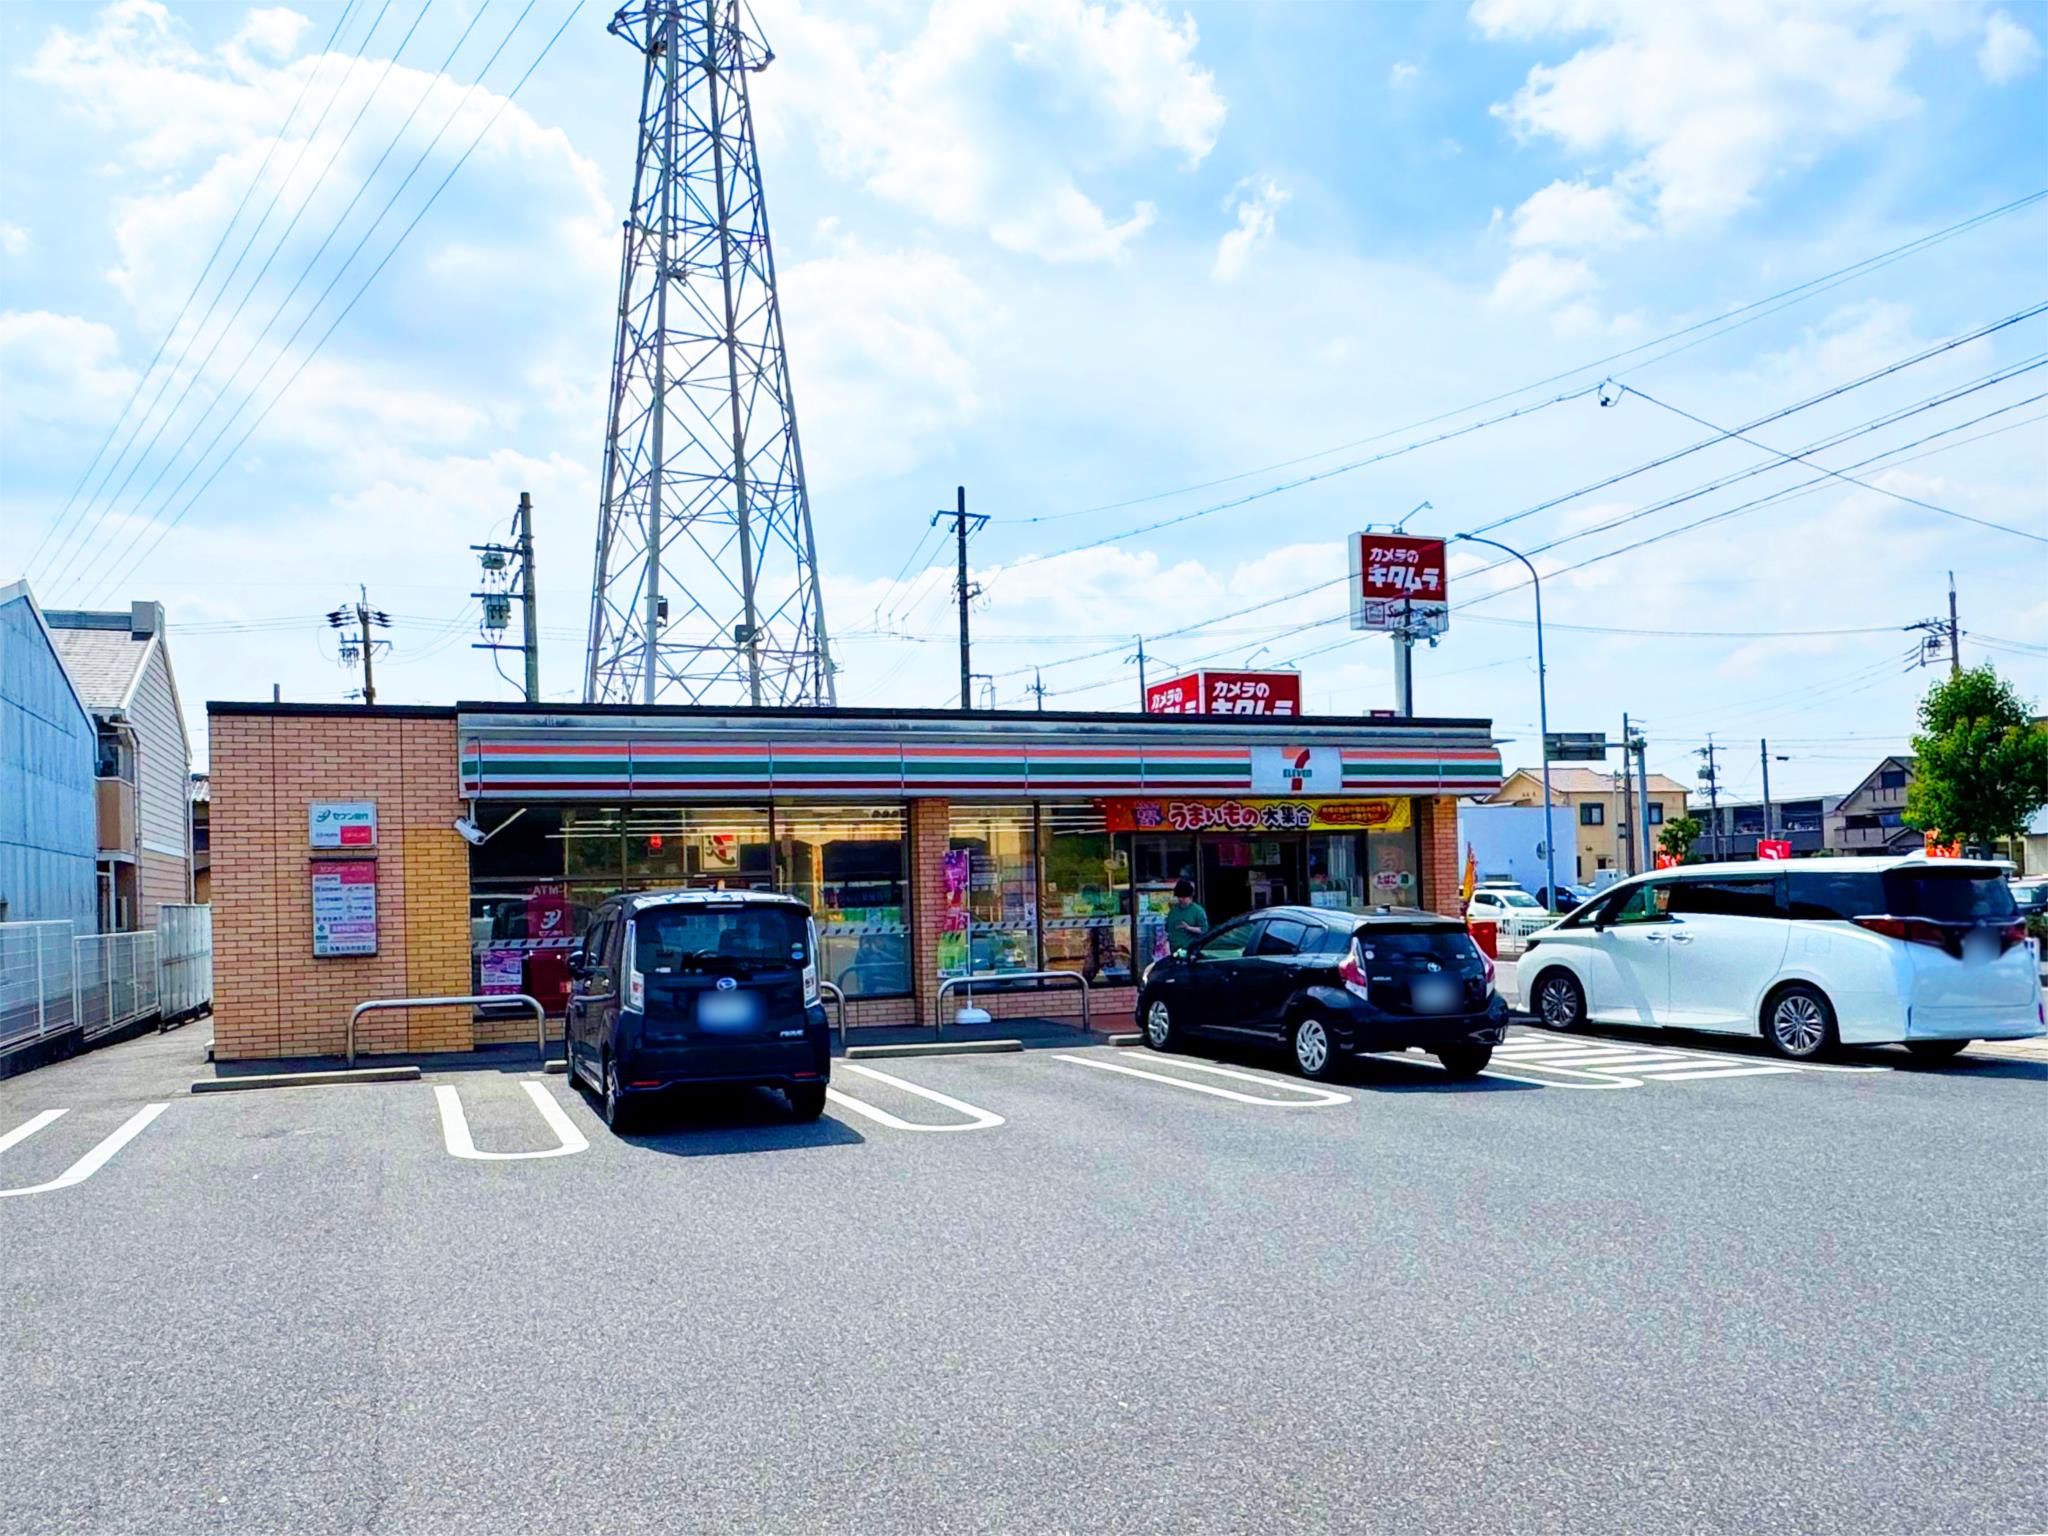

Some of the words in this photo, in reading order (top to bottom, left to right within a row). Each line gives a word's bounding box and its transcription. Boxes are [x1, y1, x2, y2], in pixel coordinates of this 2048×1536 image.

[1369, 547, 1419, 563] カメラの
[1368, 564, 1440, 592] キタムラ
[1212, 681, 1270, 698] カメラの
[1151, 688, 1184, 710] カメラの
[532, 884, 560, 895] ATM
